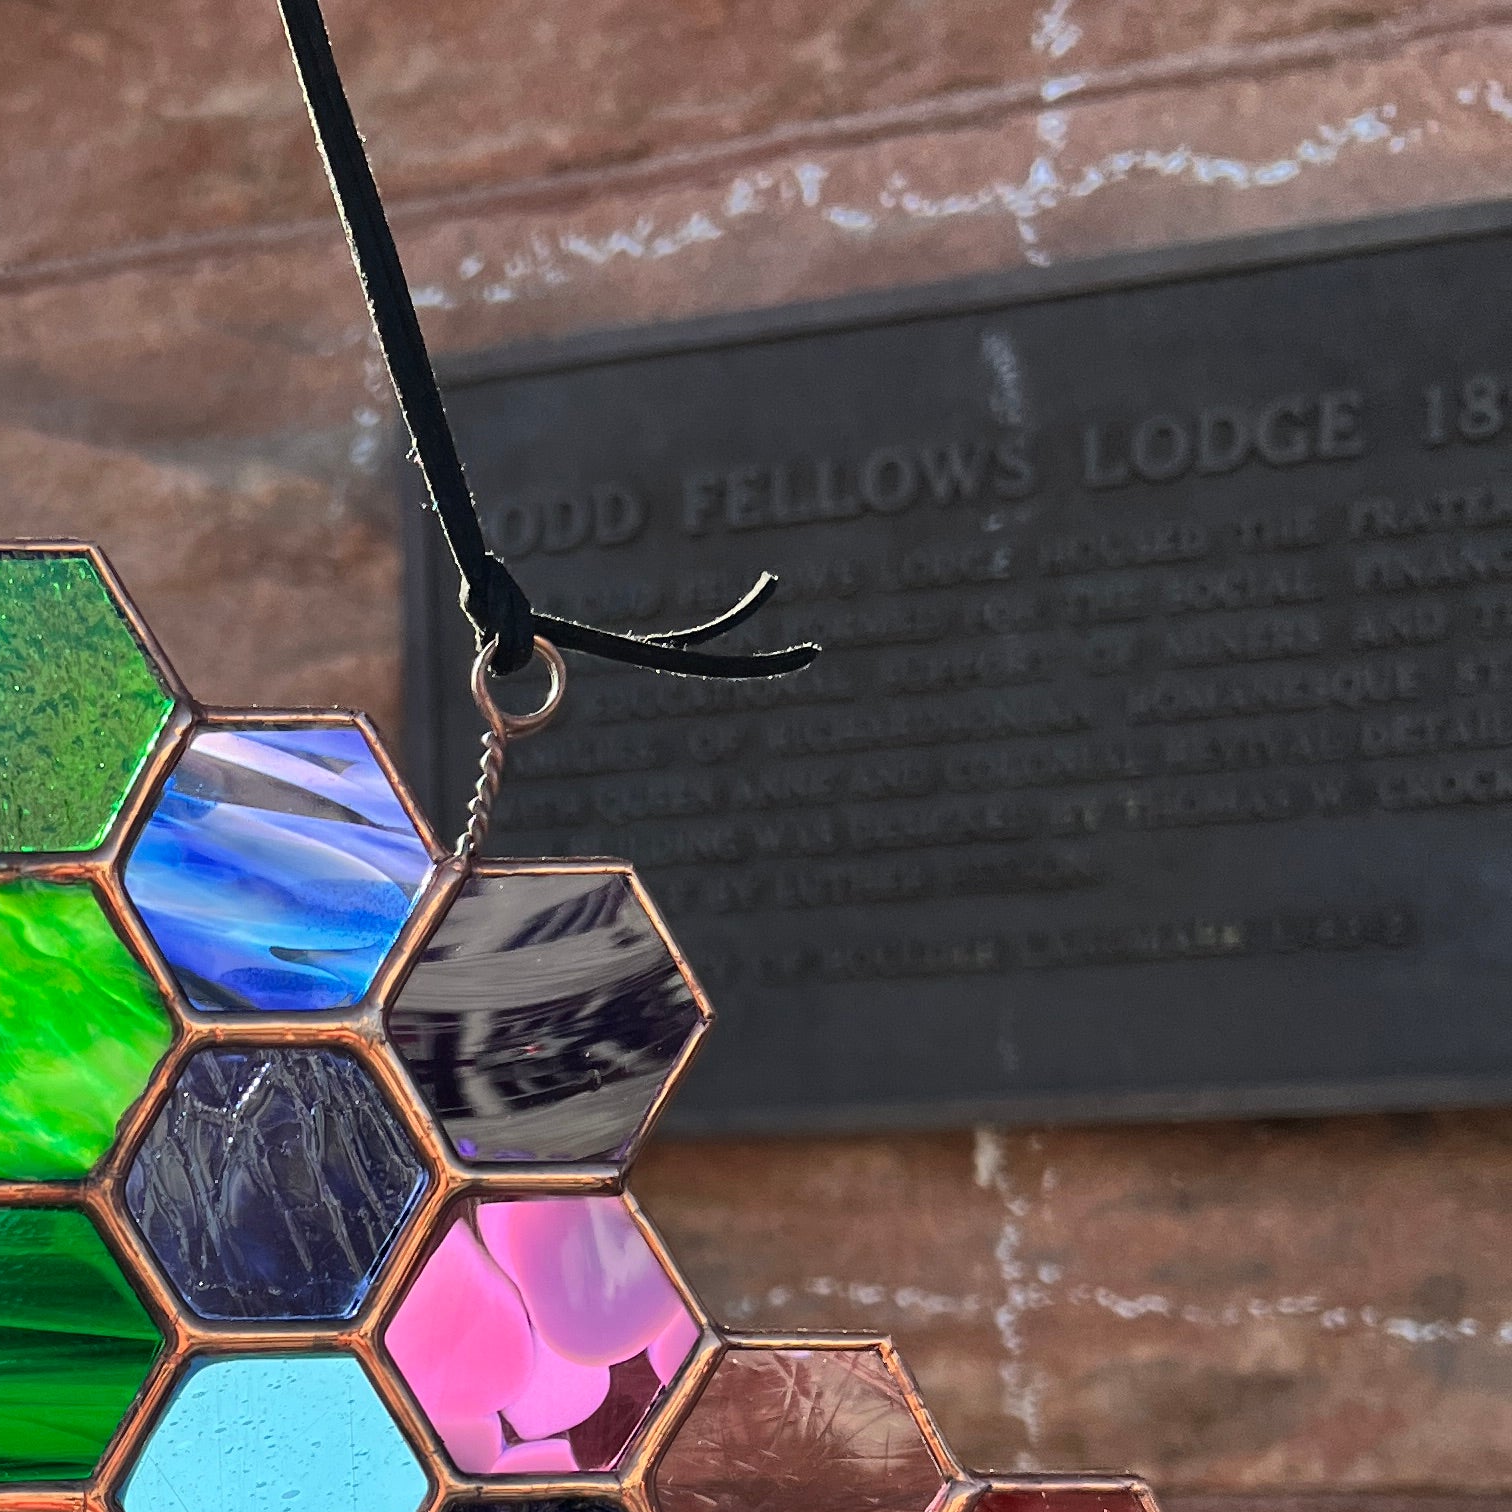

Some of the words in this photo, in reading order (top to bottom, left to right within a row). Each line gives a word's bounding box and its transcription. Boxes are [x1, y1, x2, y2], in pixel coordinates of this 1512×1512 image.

[487, 478, 642, 557] ODD
[682, 432, 1035, 533] FELLOWS
[1083, 388, 1365, 488] LODGE
[1424, 373, 1512, 445] 18
[574, 573, 660, 618] ODD
